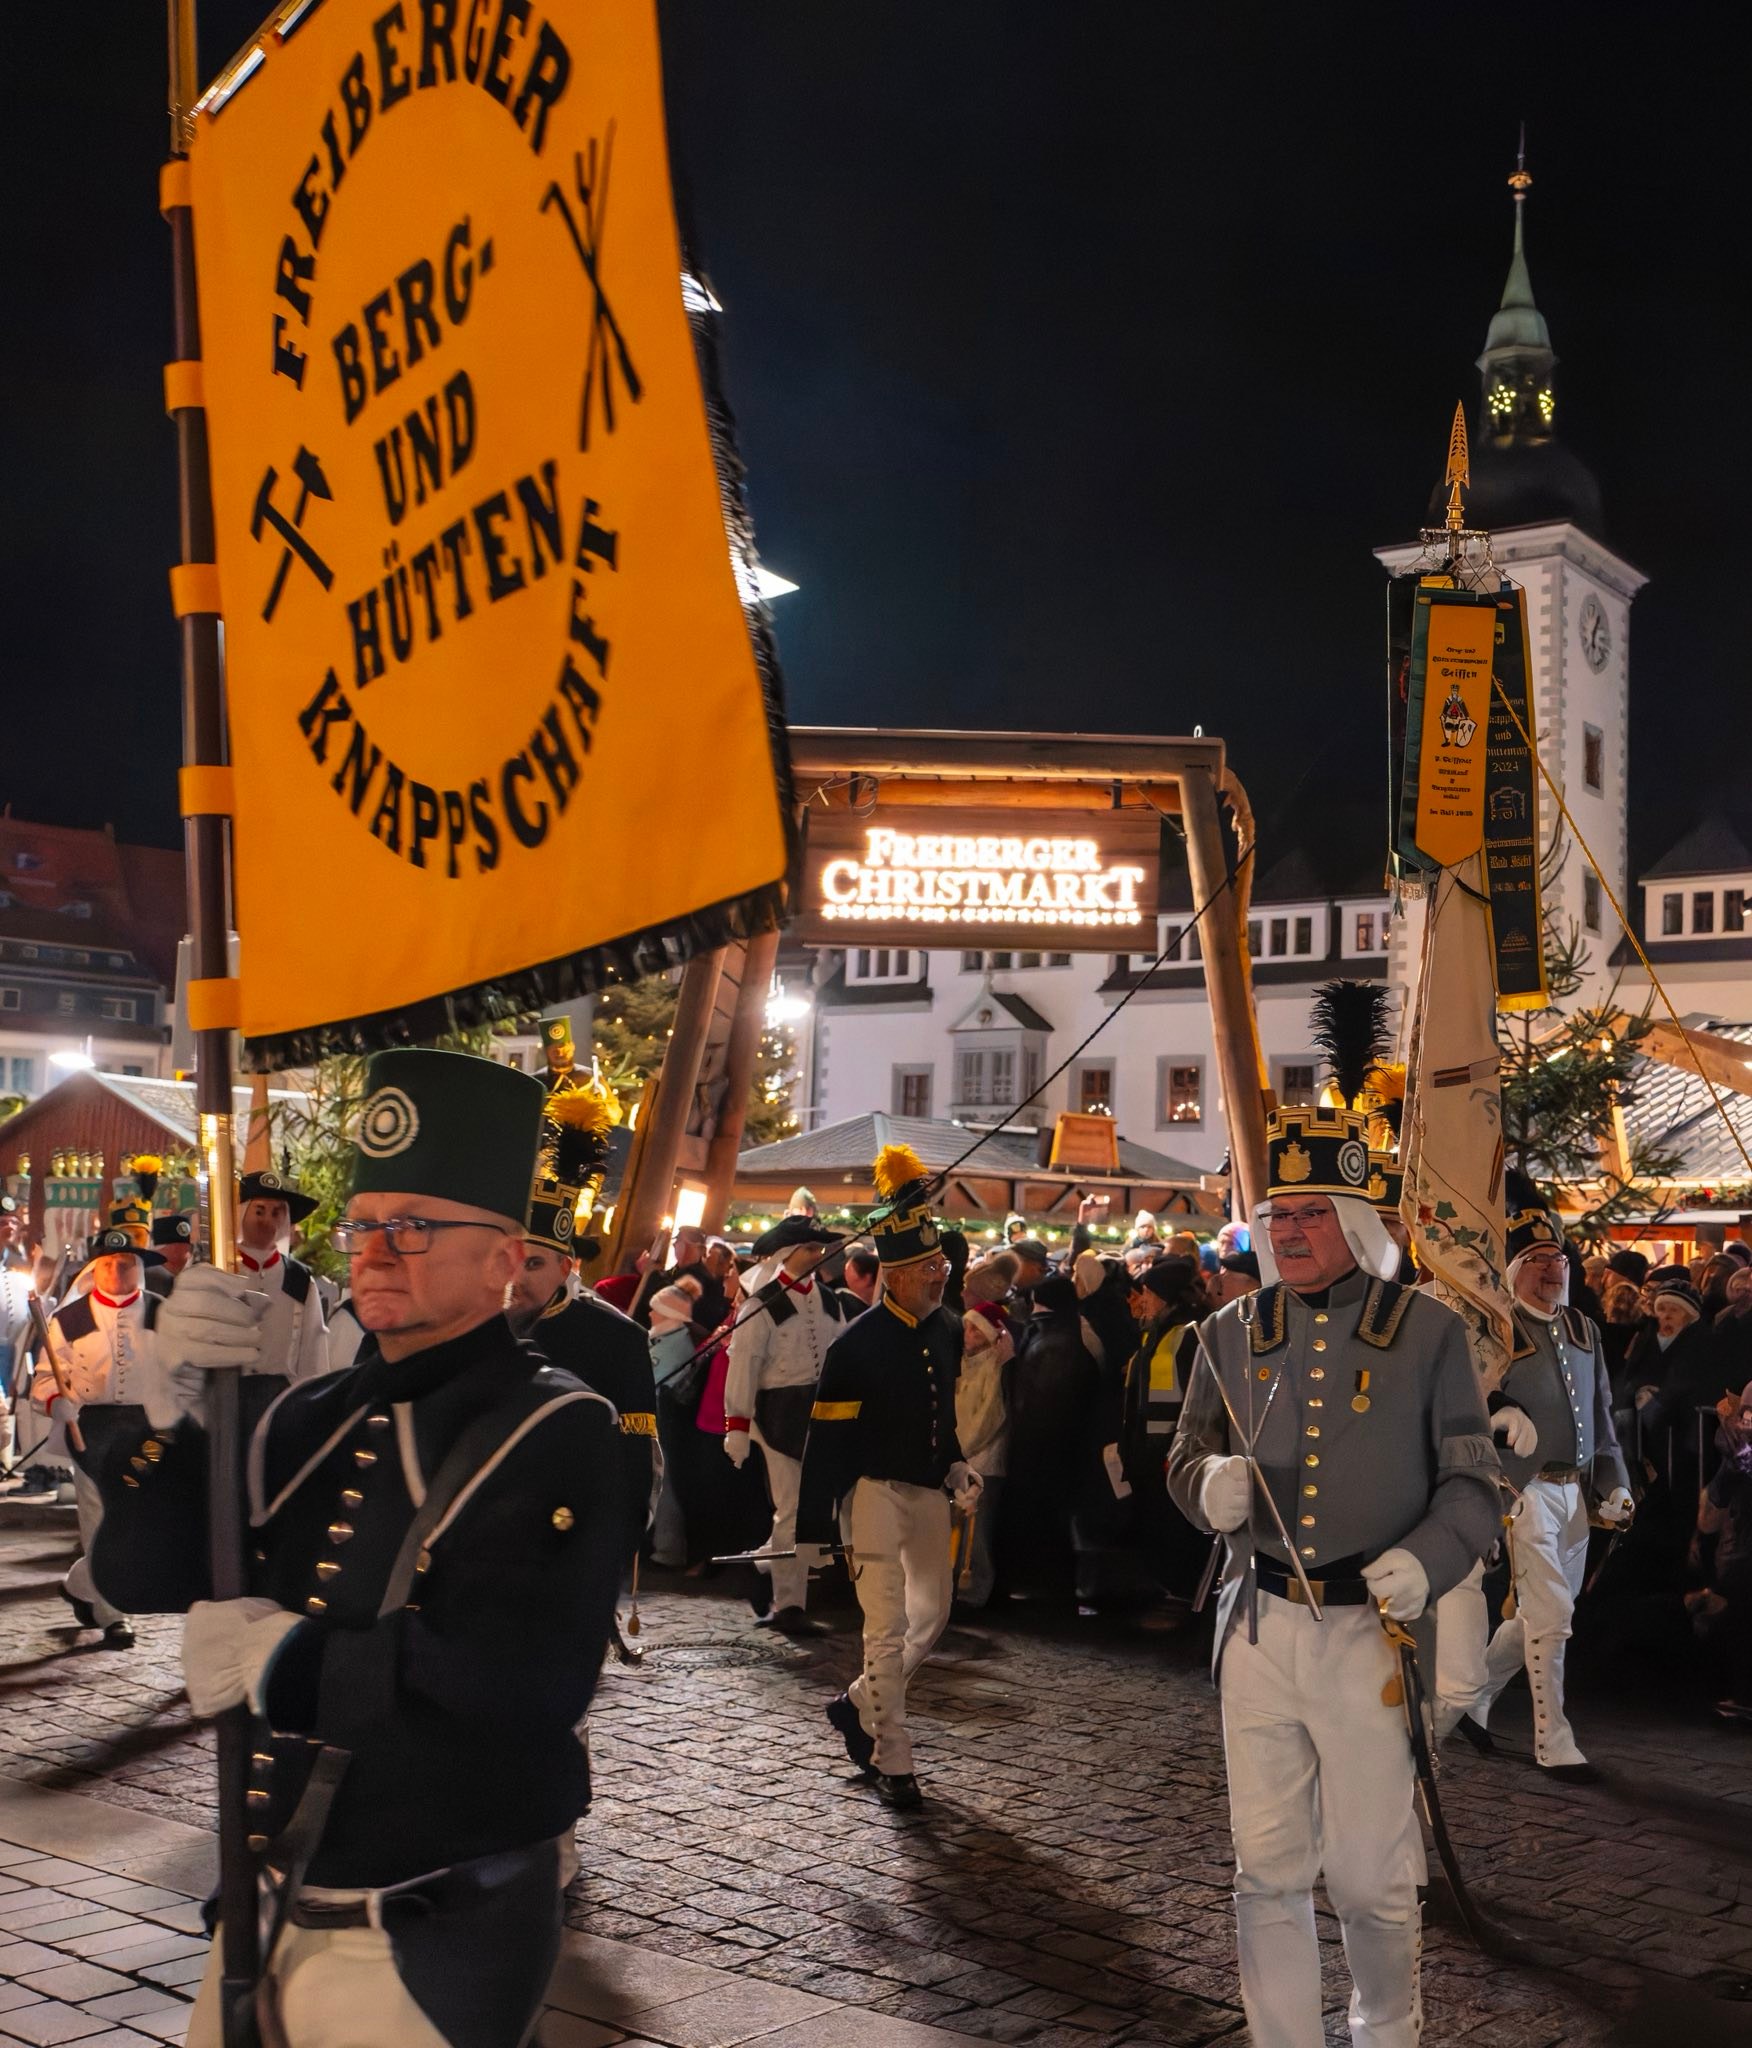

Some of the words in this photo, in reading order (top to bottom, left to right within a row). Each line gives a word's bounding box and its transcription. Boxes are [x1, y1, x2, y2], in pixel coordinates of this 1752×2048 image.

[272, 0, 572, 391] FREIBERGER
[373, 369, 475, 528] UND
[346, 459, 565, 689] HÜTTEN
[297, 497, 619, 879] KNAPPSCHAFT
[822, 859, 1145, 910] CHRISTMARKT
[866, 828, 1101, 871] FREIBERGER
